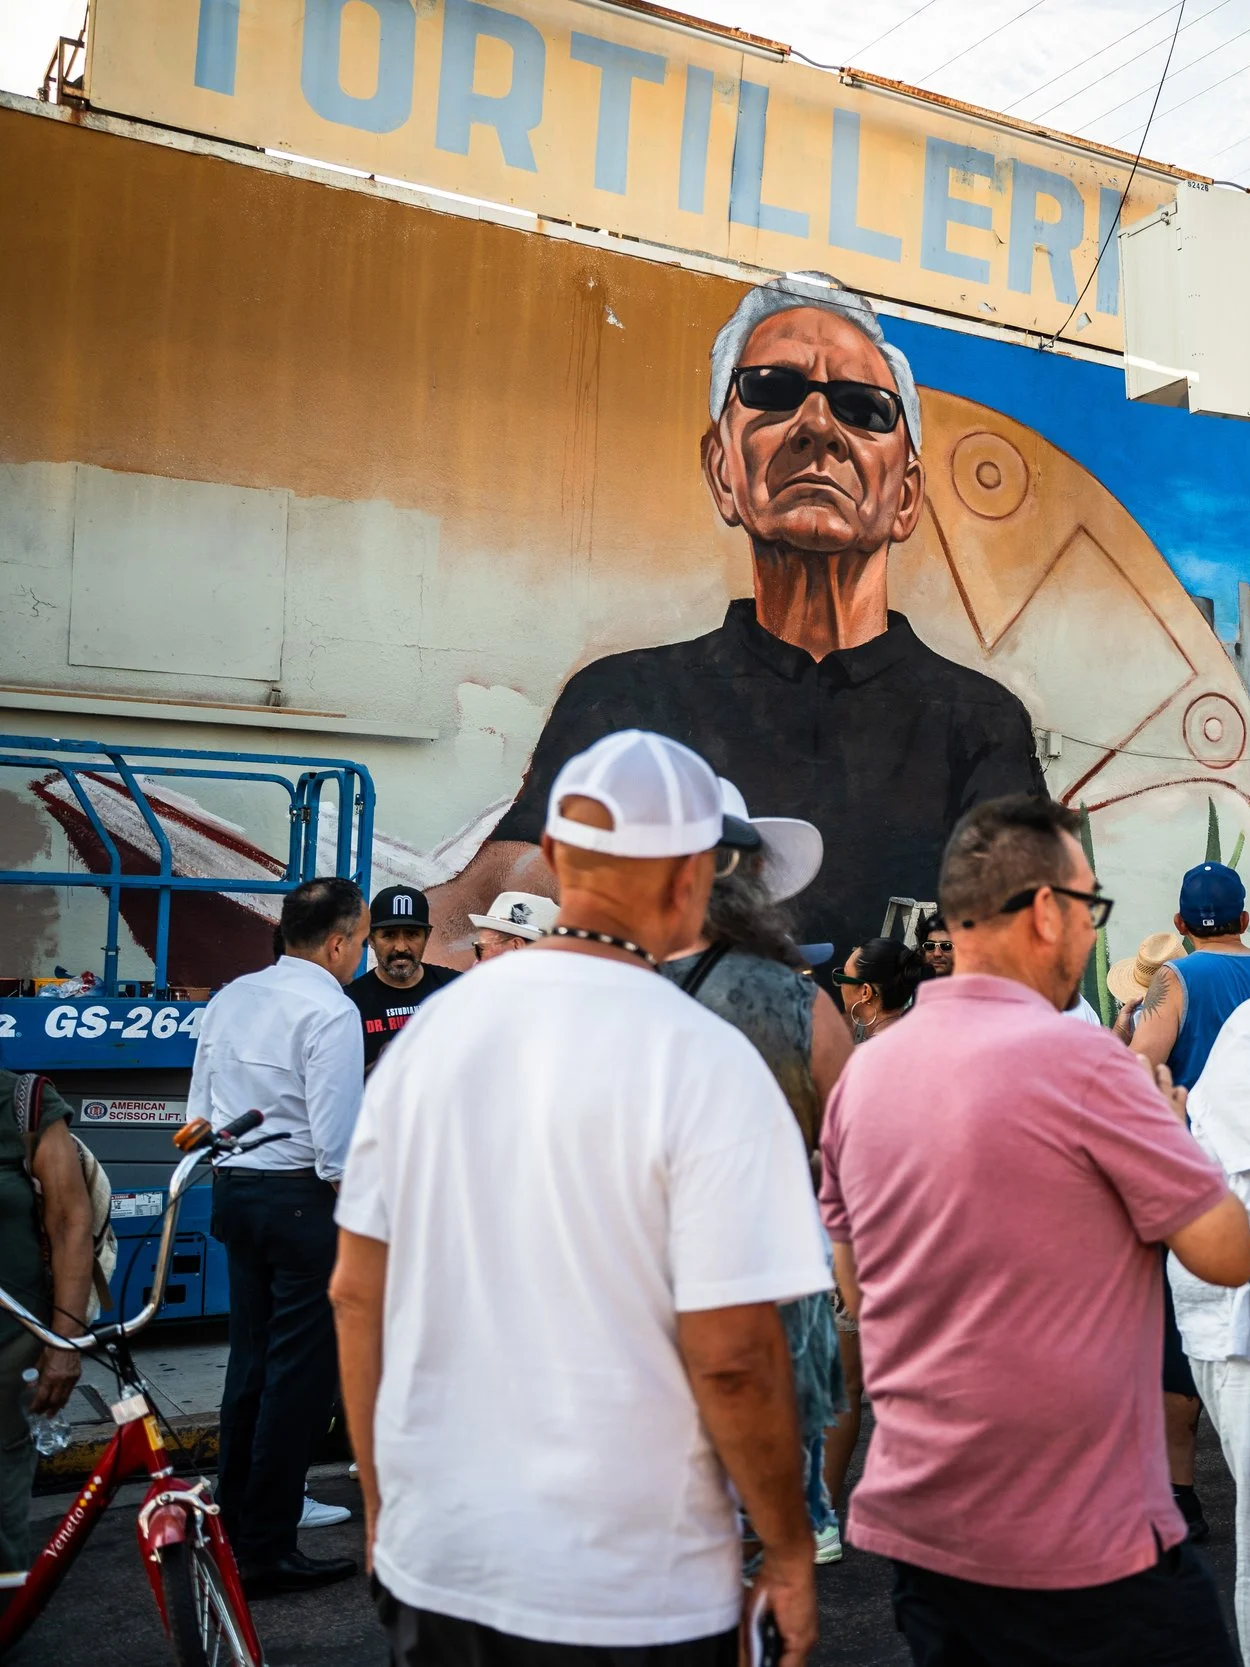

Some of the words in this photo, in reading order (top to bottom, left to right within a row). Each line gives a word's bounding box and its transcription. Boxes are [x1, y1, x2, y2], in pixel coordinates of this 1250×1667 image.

[366, 1019, 387, 1034] DR.
[109, 1101, 166, 1111] AMERICAN
[108, 1111, 156, 1121] SCISSOR
[158, 1112, 182, 1122] LIFT,
[42, 1507, 85, 1559] Veneto
